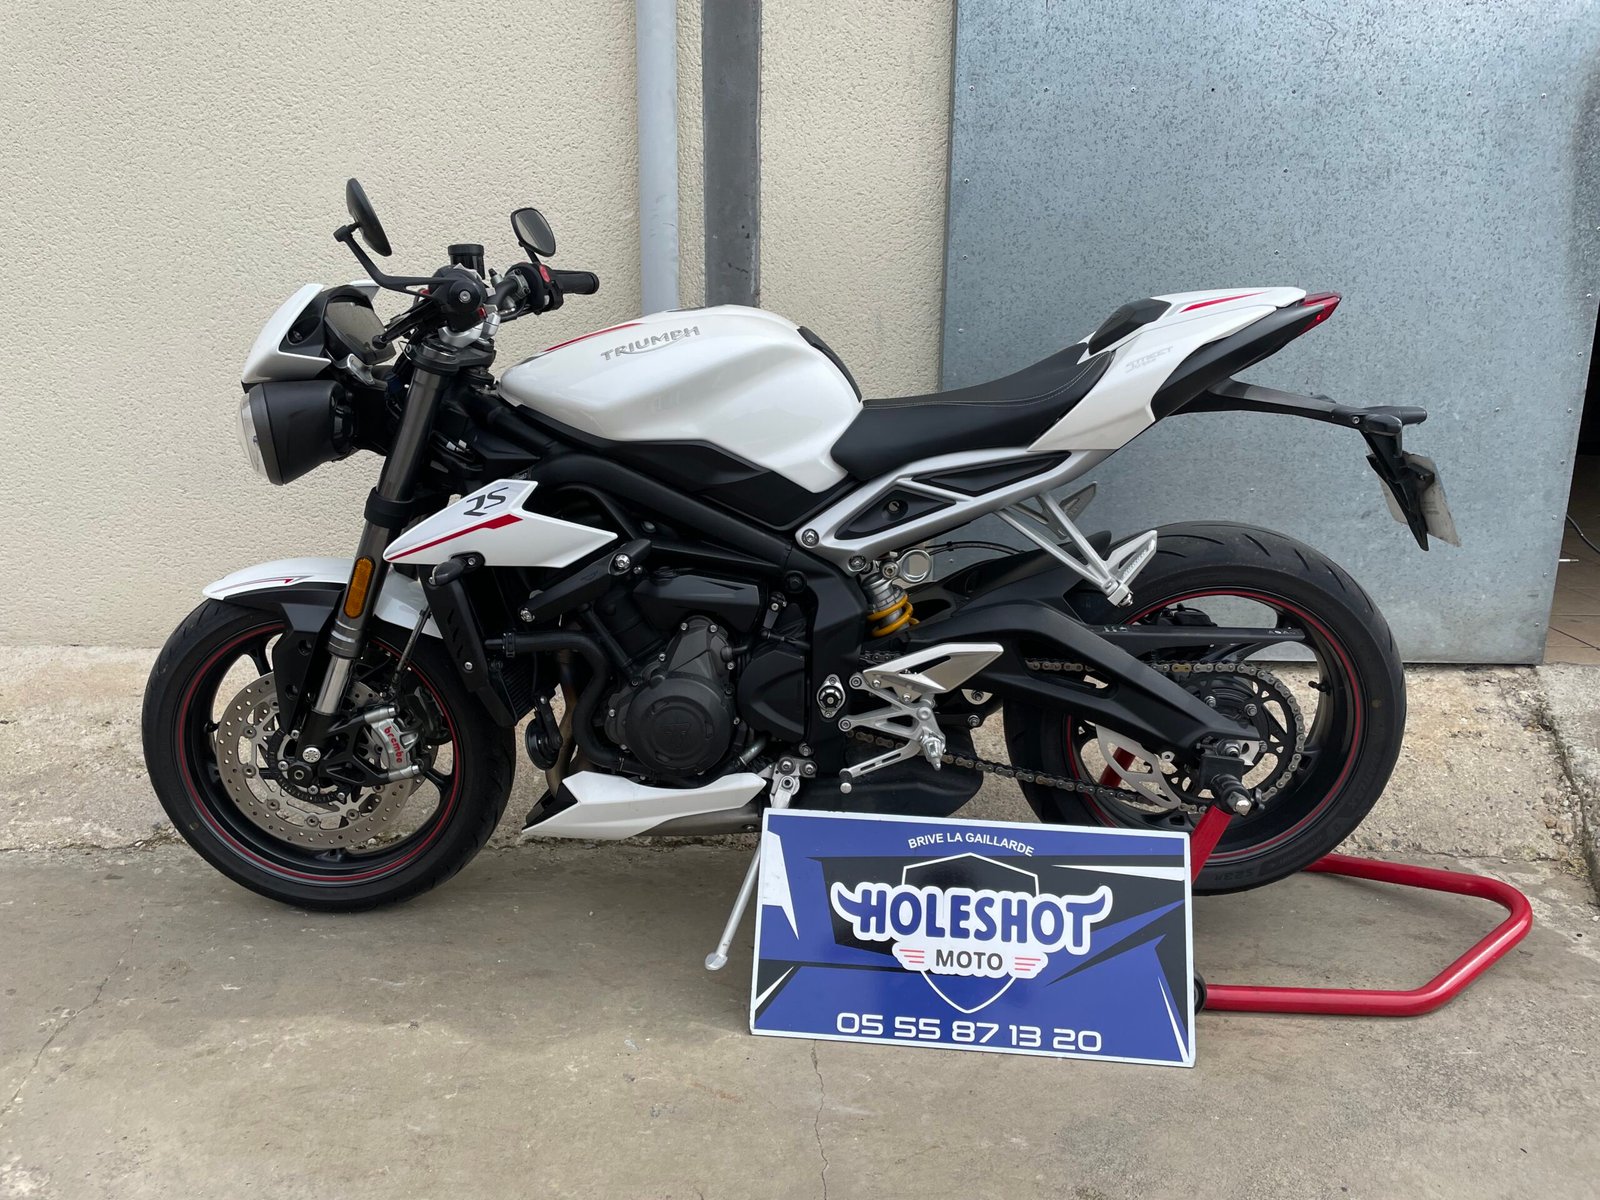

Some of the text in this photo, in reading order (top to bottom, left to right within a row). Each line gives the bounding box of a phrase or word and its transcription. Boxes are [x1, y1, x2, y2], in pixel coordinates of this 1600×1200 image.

[600, 326, 701, 361] TRIUMPH
[384, 726, 404, 763] brembo
[908, 832, 1035, 857] BRIVE LA GAILLARDE
[837, 889, 1107, 949] HOLESHOT
[936, 949, 1003, 971] MOTO
[836, 1013, 1102, 1052] 05 55 87 13 20
